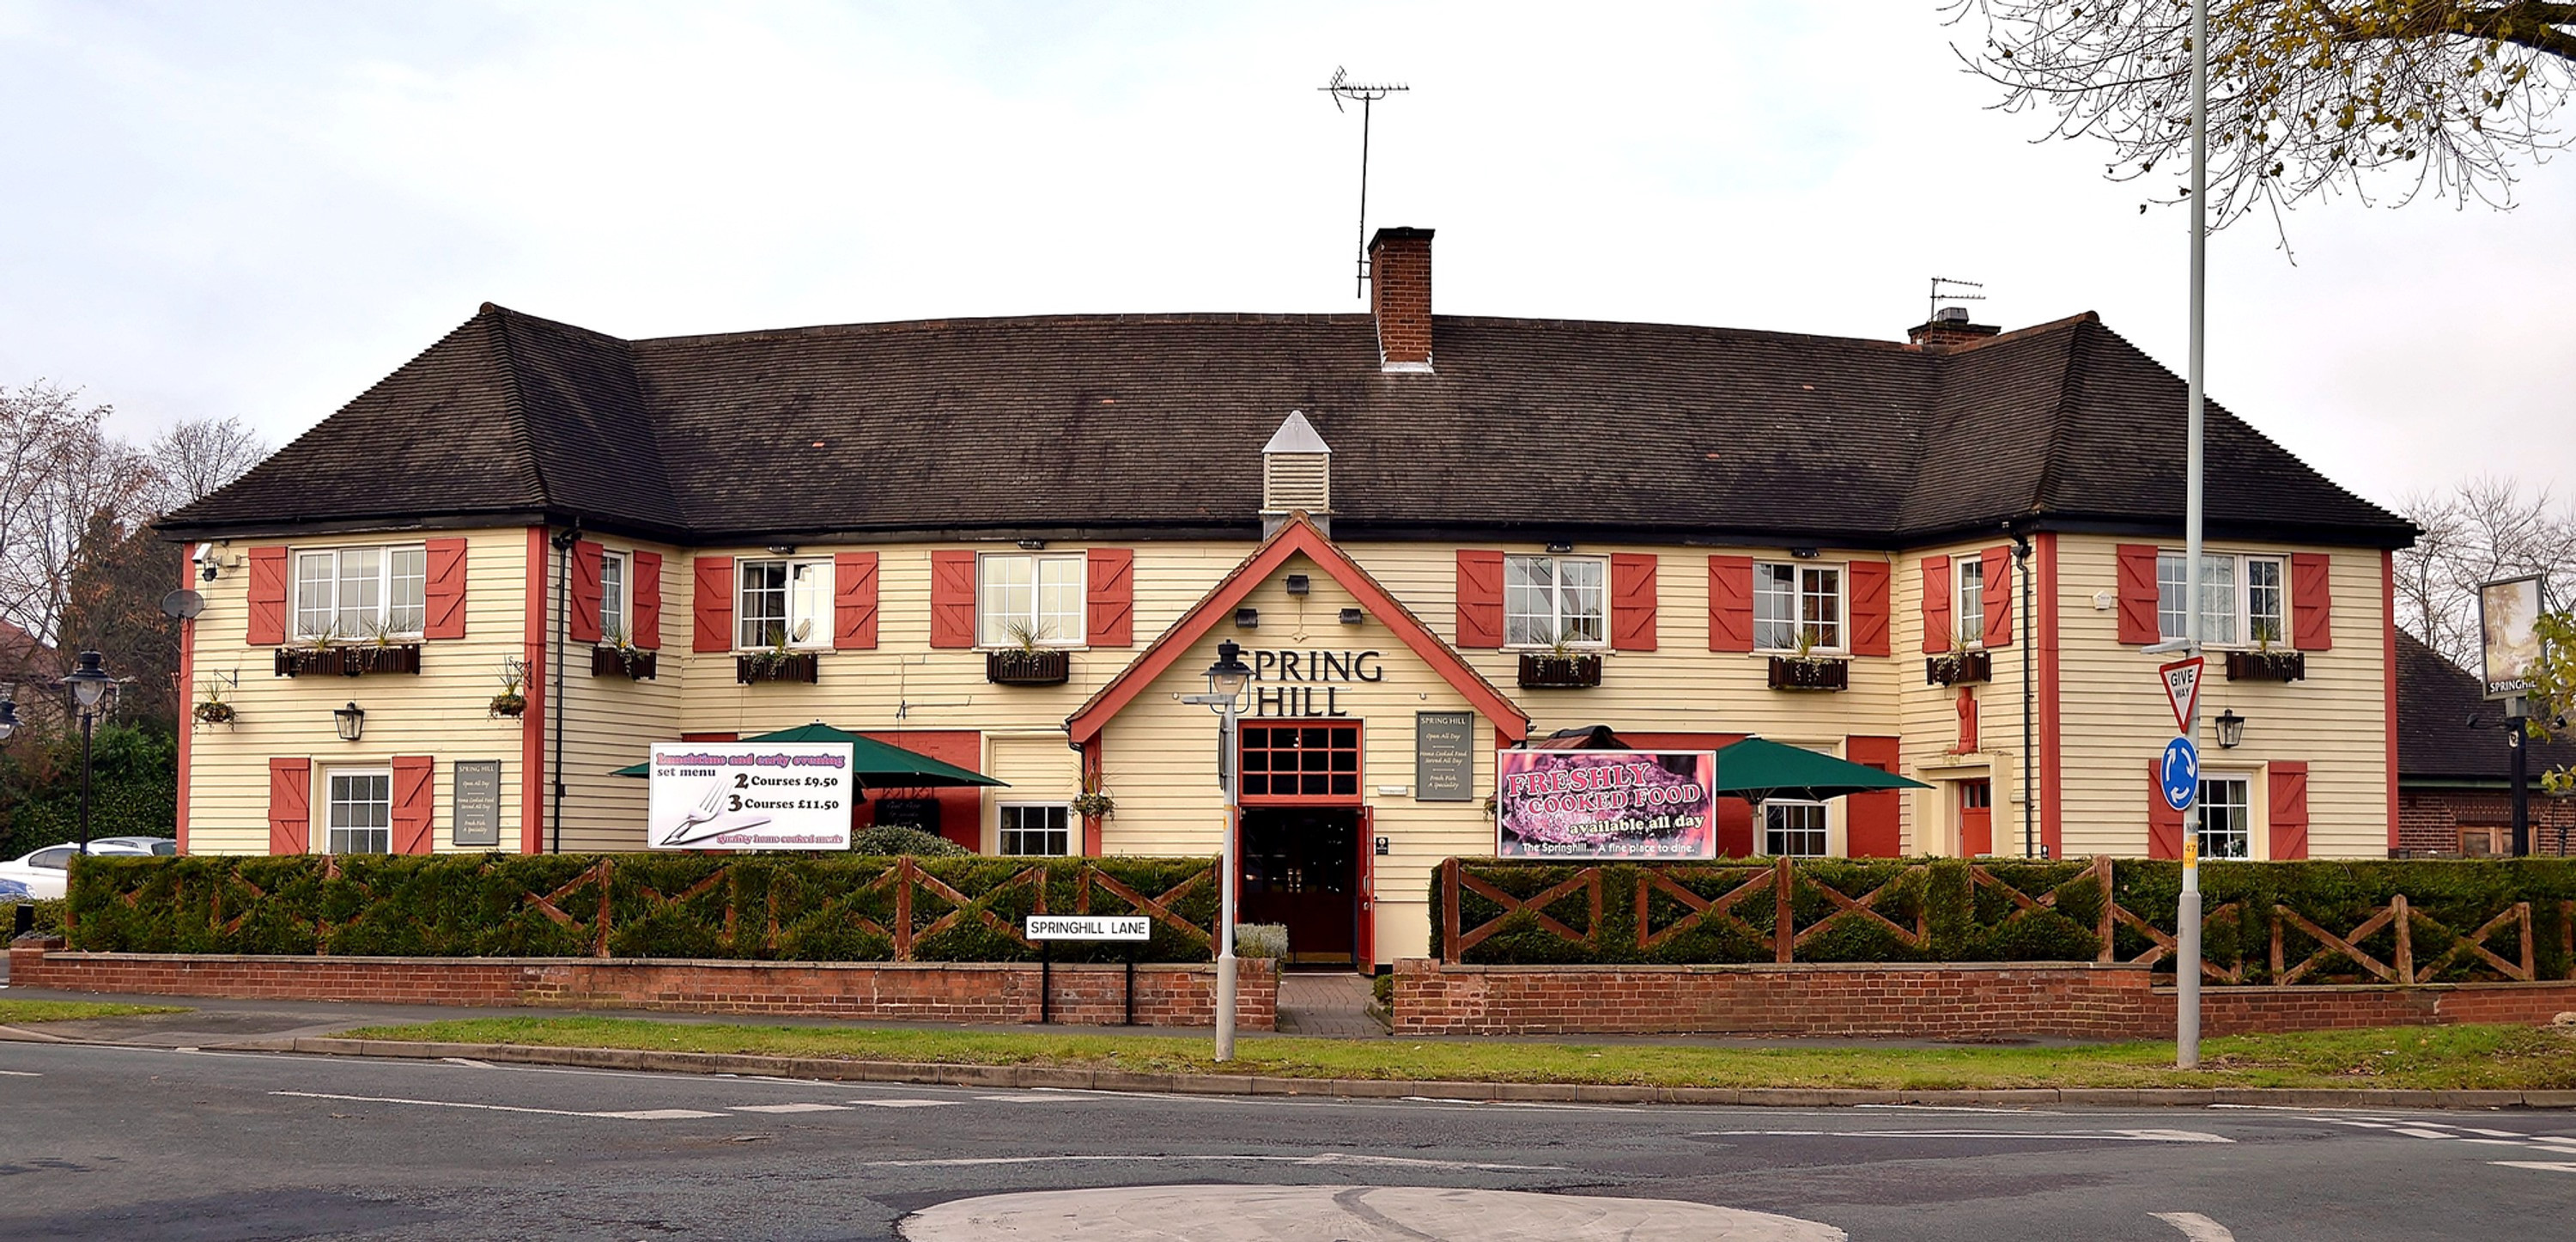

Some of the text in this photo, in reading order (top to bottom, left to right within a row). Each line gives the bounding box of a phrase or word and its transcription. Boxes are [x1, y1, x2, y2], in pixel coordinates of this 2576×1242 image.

[2171, 669, 2194, 687] GIVE
[2175, 687, 2190, 698] WAY
[1256, 686, 1347, 716] HILL
[1425, 733, 1440, 741] Open
[1450, 733, 1461, 741] Day
[656, 752, 845, 769] Lunchtime and early evening
[1452, 758, 1463, 766] Day
[657, 768, 676, 776] set
[1506, 763, 1650, 797] FRESHLY
[734, 773, 838, 789] 2 Courses £9.50
[728, 795, 840, 812] 3 Courses £11.50
[1528, 784, 1700, 814] COOKED FOOD
[1569, 814, 1705, 835] available all day
[753, 834, 780, 843] home
[781, 834, 814, 843] cooked
[1522, 843, 1540, 852] The
[1598, 843, 1607, 852] A
[1608, 843, 1627, 852] fine
[1629, 843, 1656, 854] place
[1658, 843, 1669, 852] to
[1671, 843, 1695, 852] dine.
[1030, 921, 1146, 935] SPRINGHILL LANE
